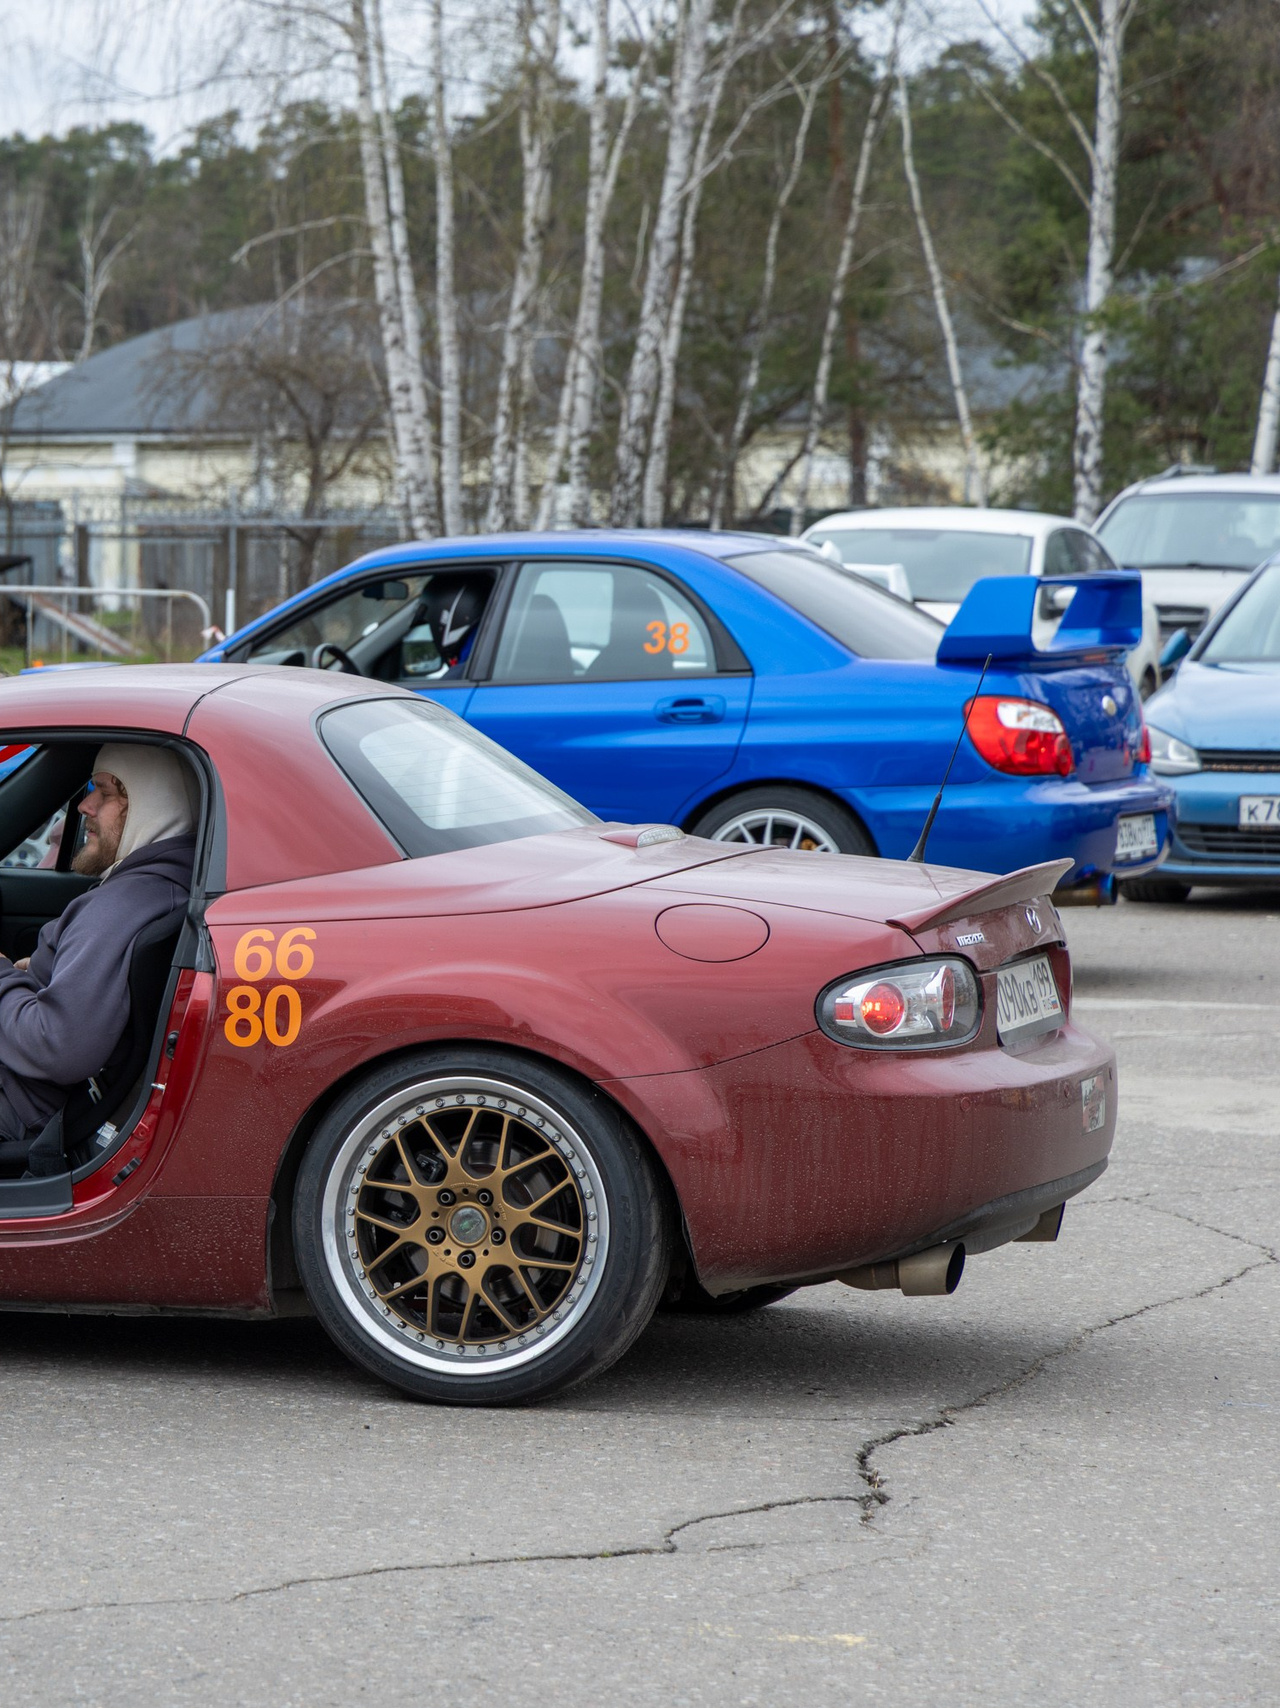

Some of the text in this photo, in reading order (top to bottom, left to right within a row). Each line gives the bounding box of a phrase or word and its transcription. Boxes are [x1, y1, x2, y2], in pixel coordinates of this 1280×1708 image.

[643, 620, 690, 655] 38
[1247, 800, 1280, 821] К7
[234, 927, 317, 981] 66
[1032, 961, 1052, 999] 199
[224, 984, 302, 1047] 80
